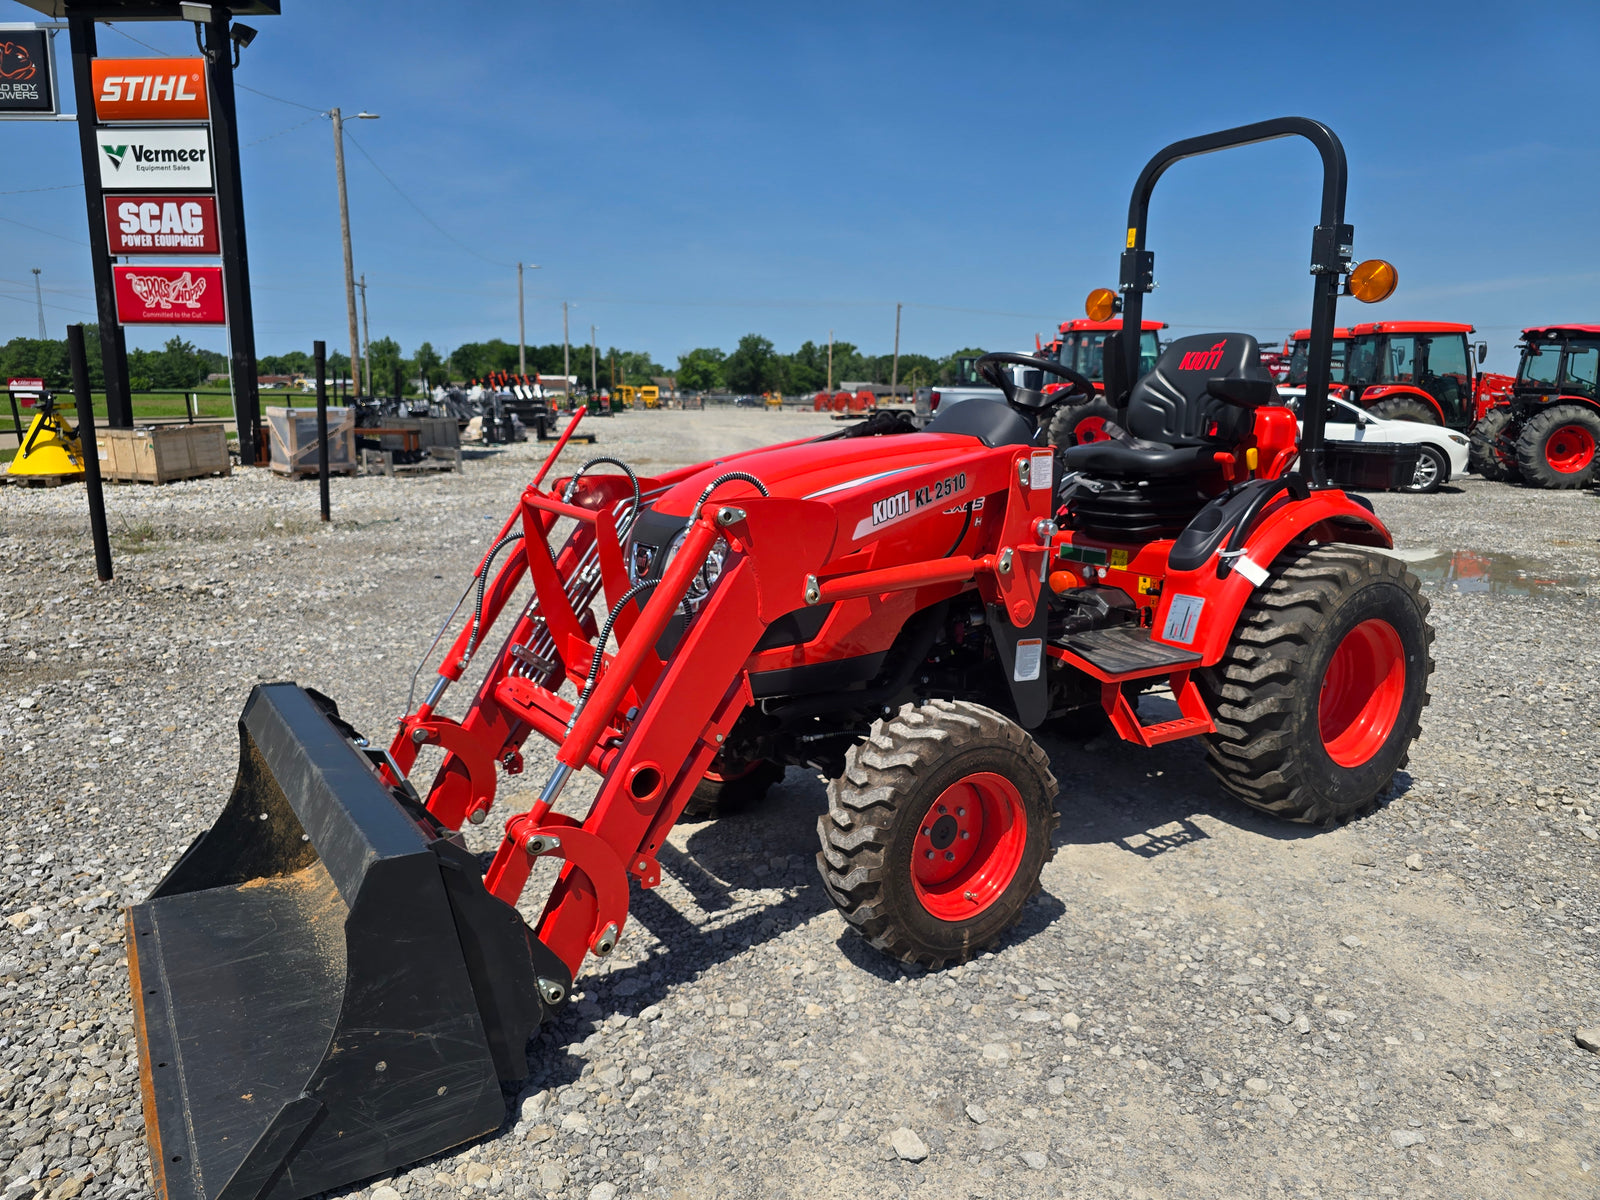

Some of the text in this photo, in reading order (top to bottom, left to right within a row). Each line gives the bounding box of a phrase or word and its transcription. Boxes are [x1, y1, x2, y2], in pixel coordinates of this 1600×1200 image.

[13, 83, 37, 91] BOY
[100, 75, 196, 101] STIHL
[131, 145, 206, 162] Vermeer
[118, 202, 204, 234] SCAG
[121, 235, 205, 247] POWER EQUIPMENT
[1178, 350, 1225, 370] KIOTI
[872, 472, 966, 526] KIOTI KL 2510
